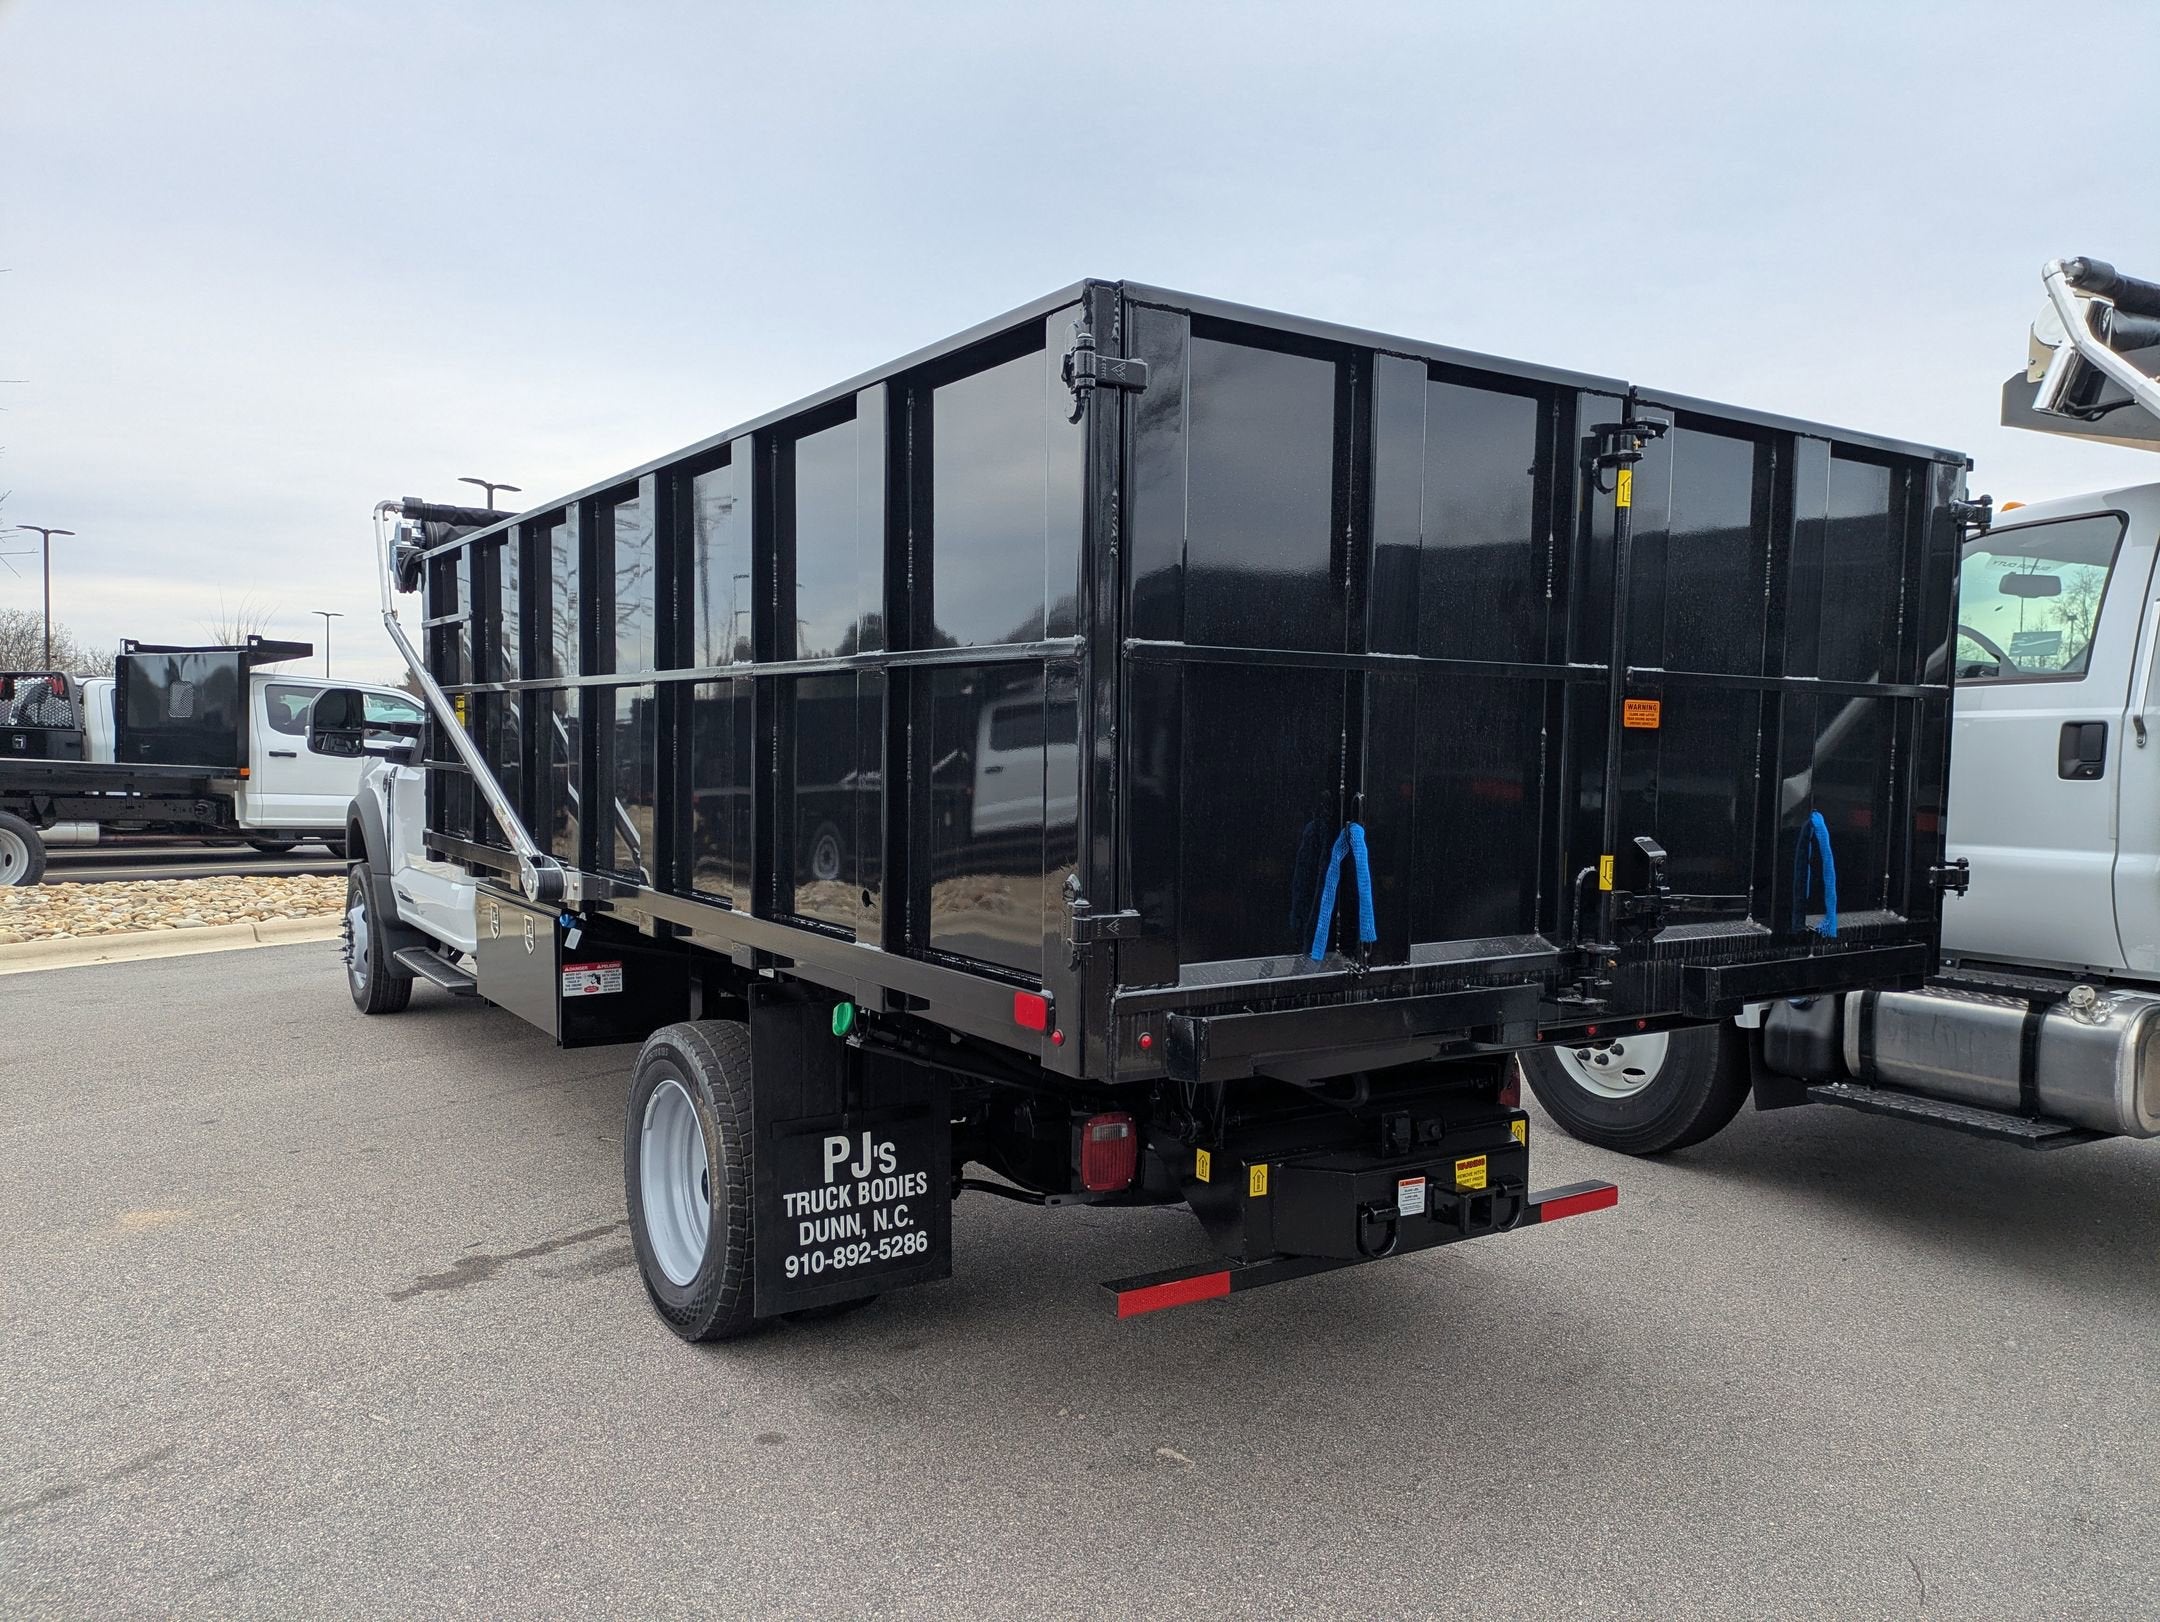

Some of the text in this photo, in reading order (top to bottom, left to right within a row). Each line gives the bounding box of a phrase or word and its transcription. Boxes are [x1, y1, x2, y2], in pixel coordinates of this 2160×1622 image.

[1628, 703, 1656, 711] WARNING
[782, 1171, 928, 1218] TRUCK BODIES
[799, 1204, 914, 1247] DUNN, N.C.
[784, 1230, 928, 1279] 910-892-5286
